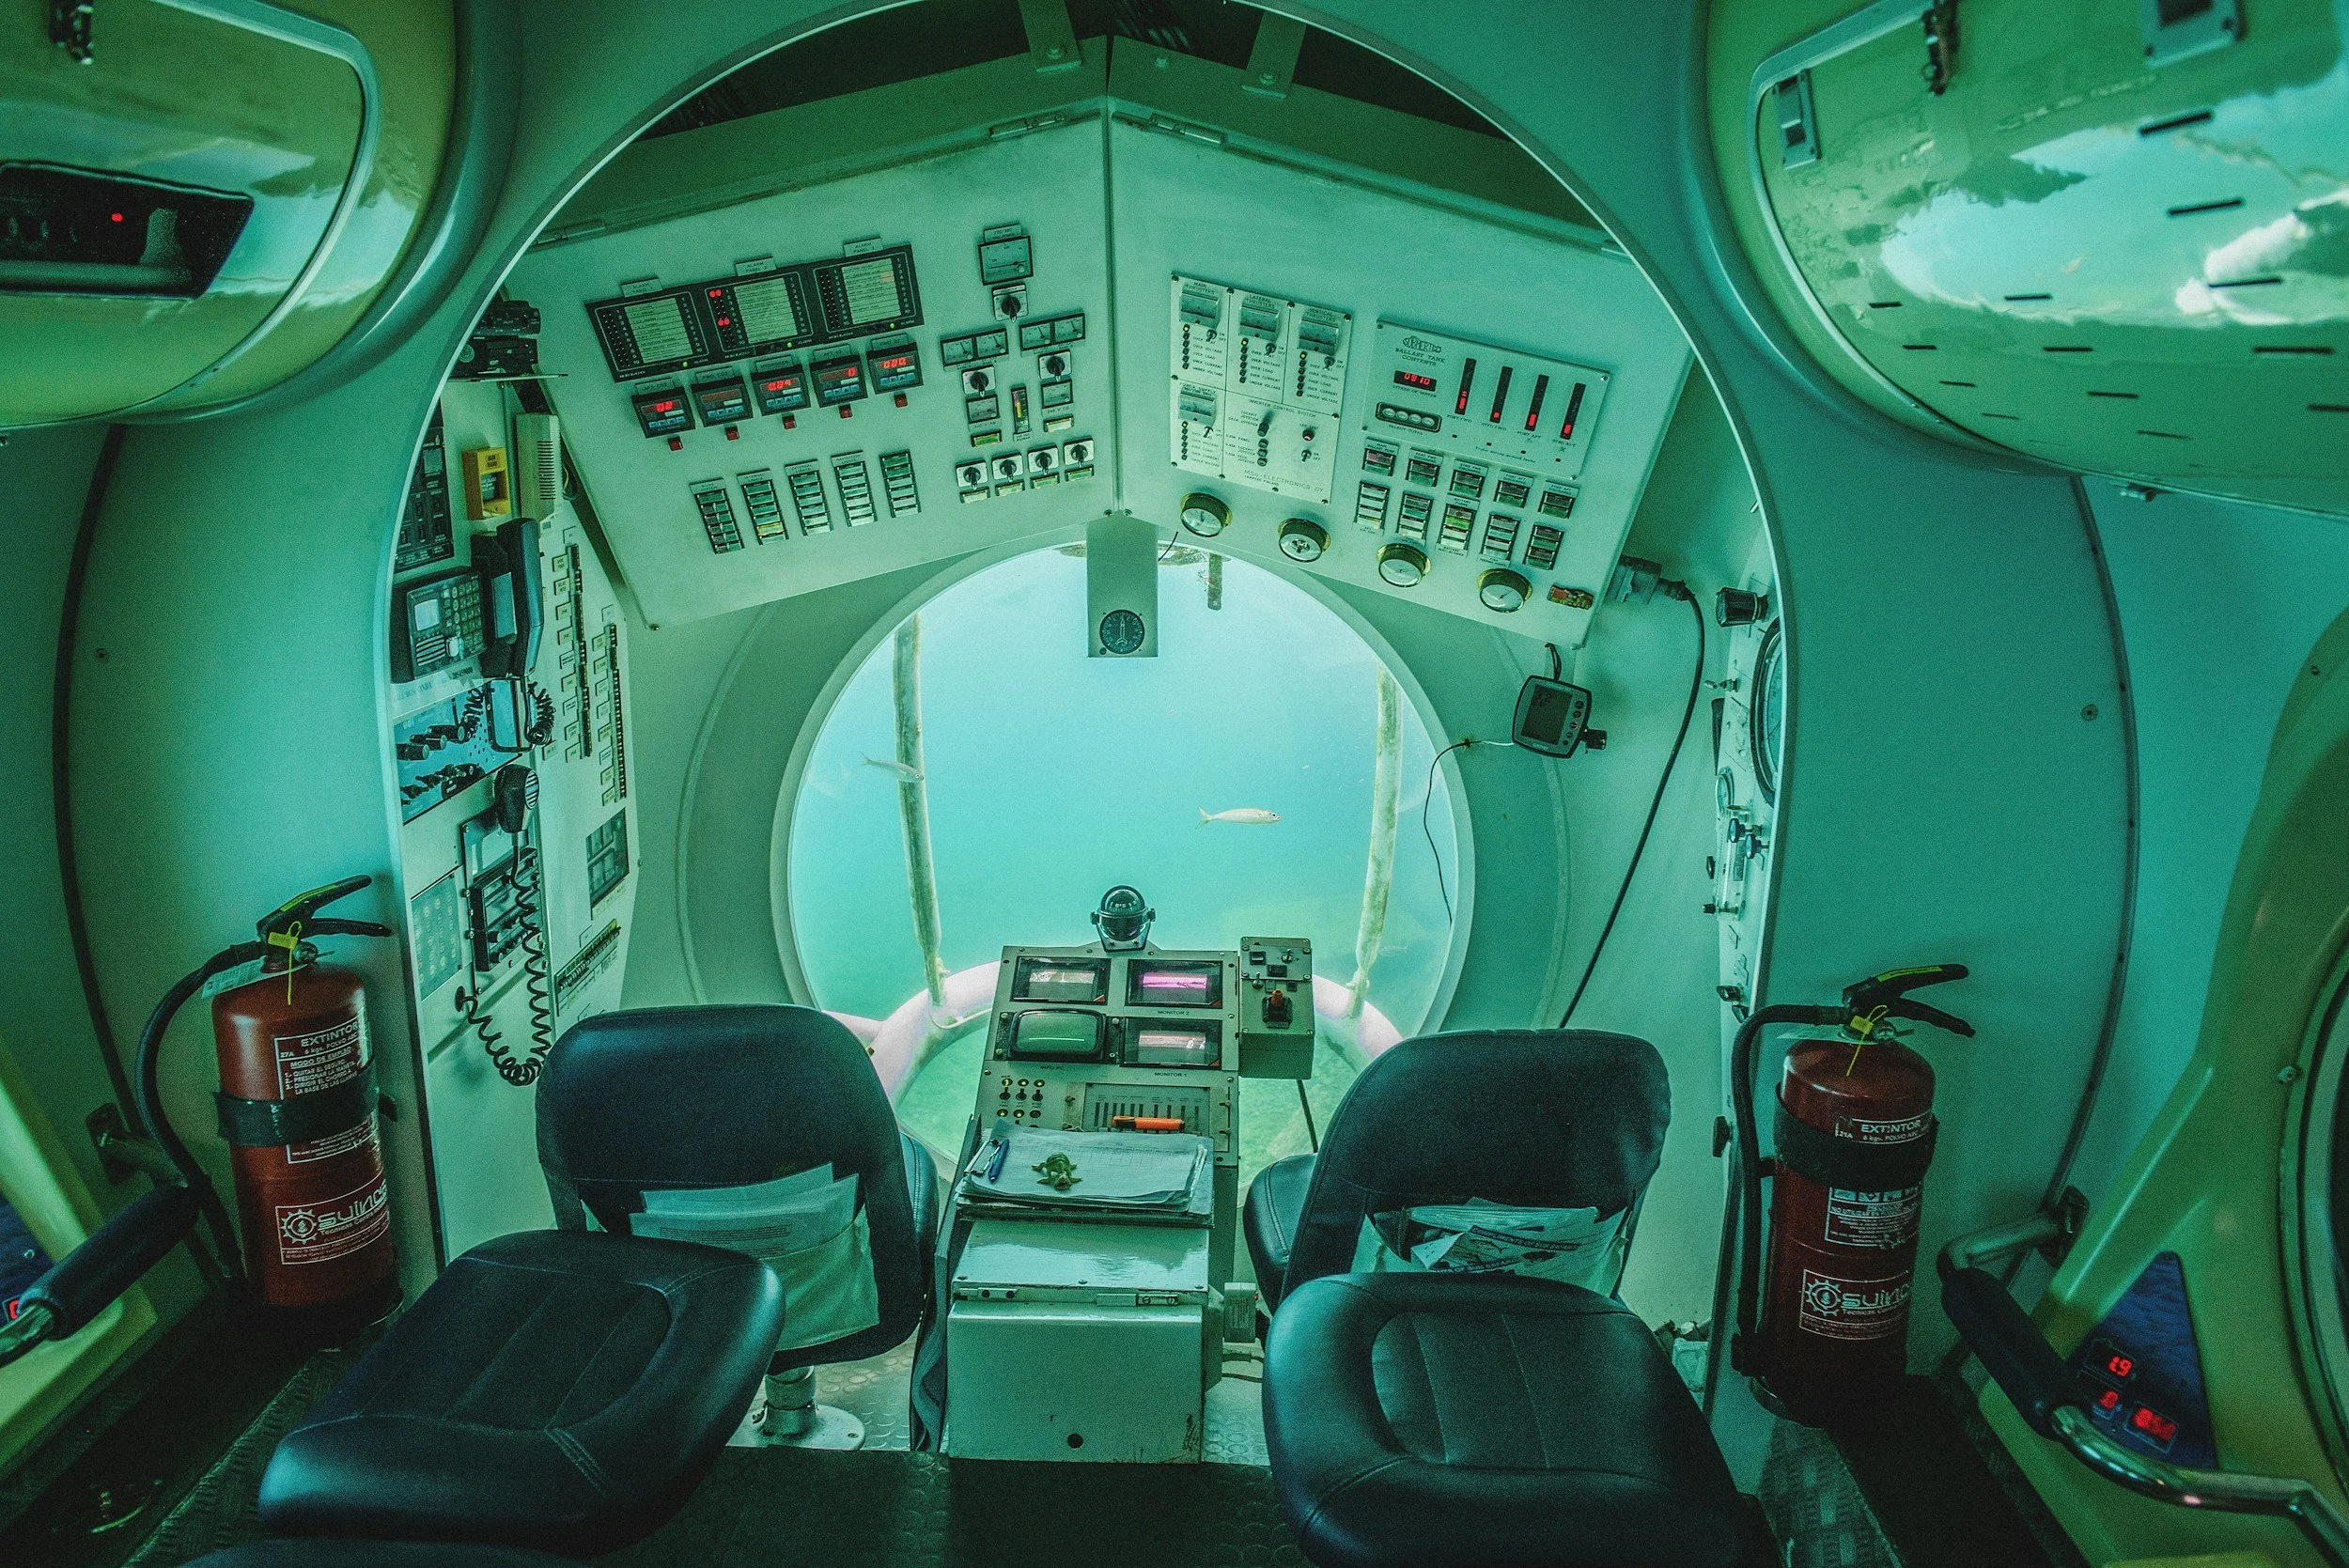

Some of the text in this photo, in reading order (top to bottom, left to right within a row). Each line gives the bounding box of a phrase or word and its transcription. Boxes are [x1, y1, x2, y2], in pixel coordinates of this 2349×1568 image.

[1395, 348, 1424, 358] BALLAST
[1401, 354, 1437, 366] CONTENTS
[301, 1021, 358, 1048] EXTINTOR
[290, 1060, 315, 1069] MODO
[293, 1069, 316, 1078] QUITAR
[293, 1072, 327, 1083] PRESIONAR
[294, 1079, 317, 1089] DIRIGIR
[325, 1072, 347, 1081] CHORRO
[303, 1085, 320, 1094] BASE
